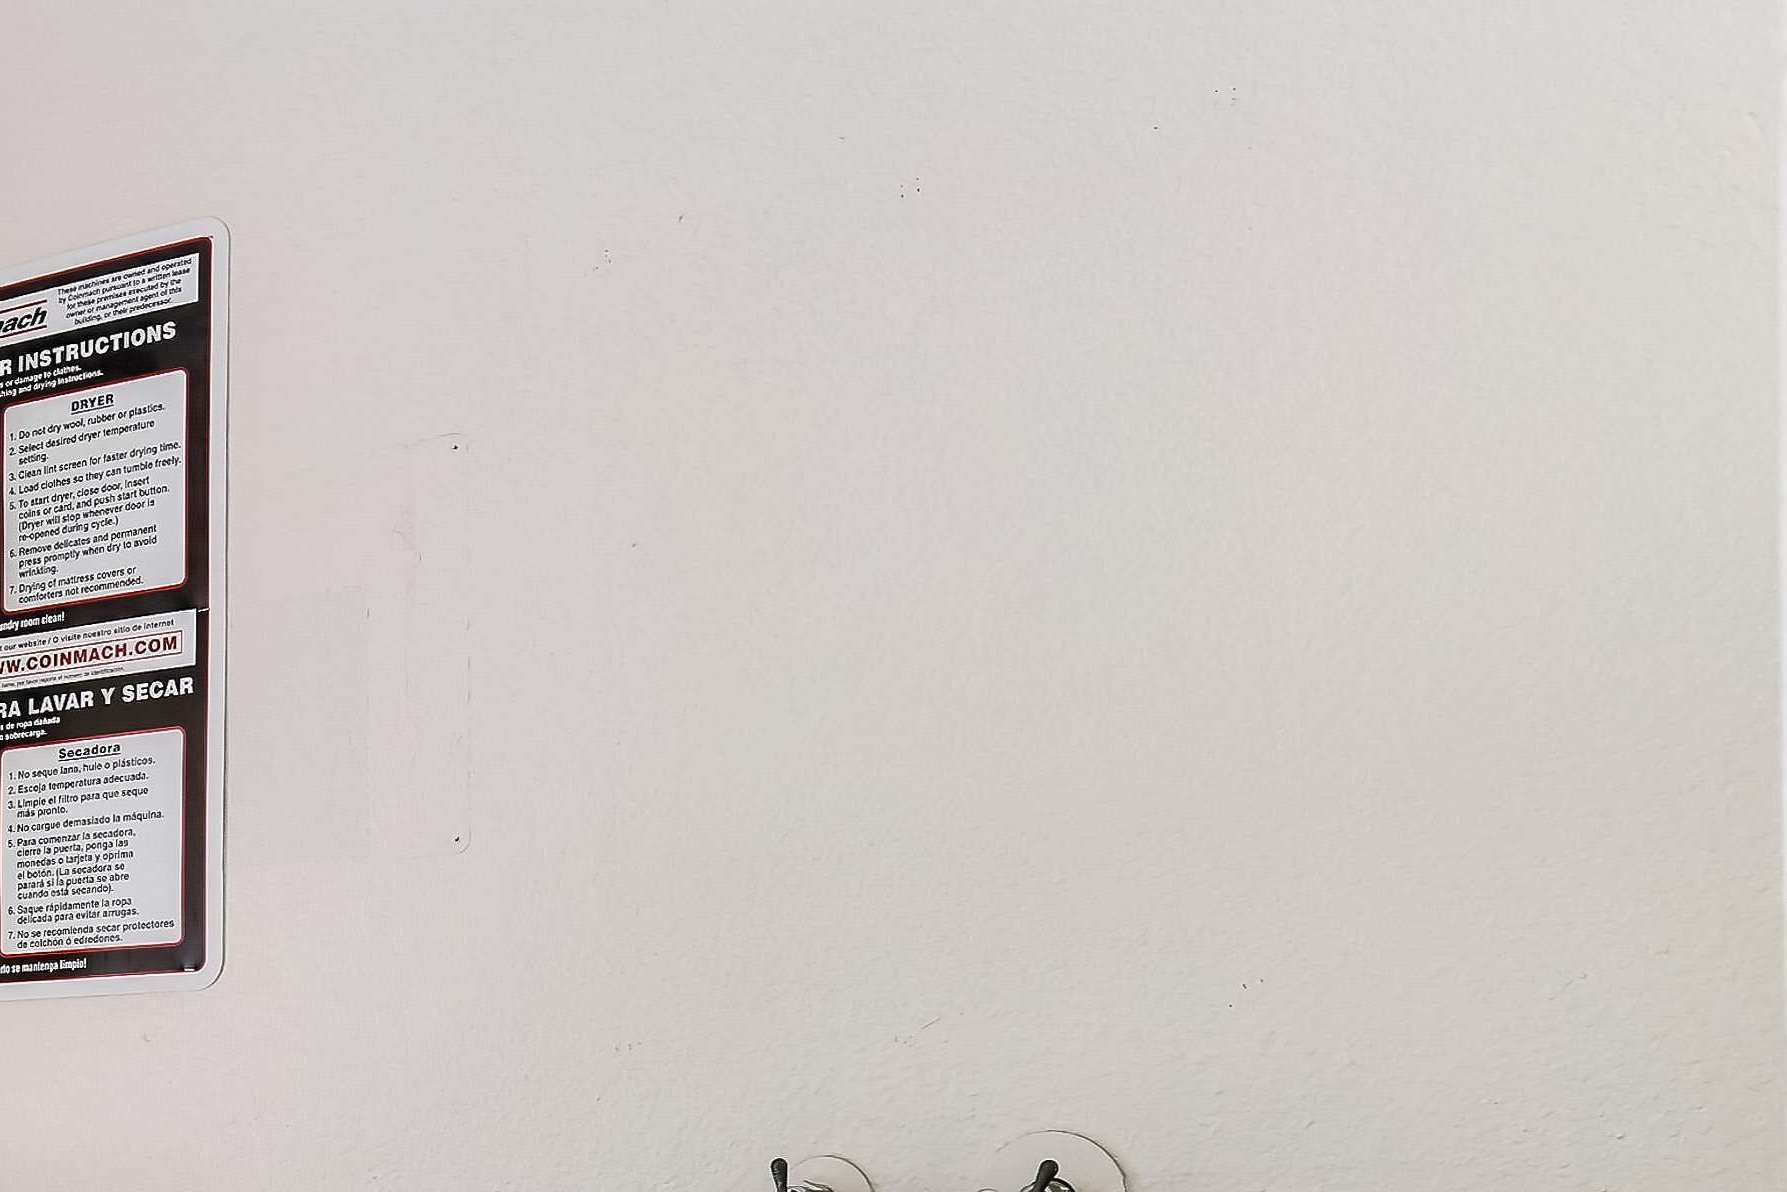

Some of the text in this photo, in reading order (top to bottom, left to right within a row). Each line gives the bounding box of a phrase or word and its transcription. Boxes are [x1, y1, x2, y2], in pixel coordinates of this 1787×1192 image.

[18, 321, 175, 372] INSTRUCTIONS
[71, 394, 113, 411] DRYER
[18, 430, 30, 439] Do
[31, 426, 45, 437] not
[46, 424, 61, 433] dry
[62, 417, 85, 430] wool,
[87, 412, 116, 425] rubber
[117, 410, 127, 419] or
[128, 403, 164, 419] plastics.
[28, 690, 93, 715] LAVAR
[100, 686, 115, 704] Y
[121, 676, 193, 702] SECAR
[58, 744, 120, 759] Secadora
[17, 770, 31, 779] No
